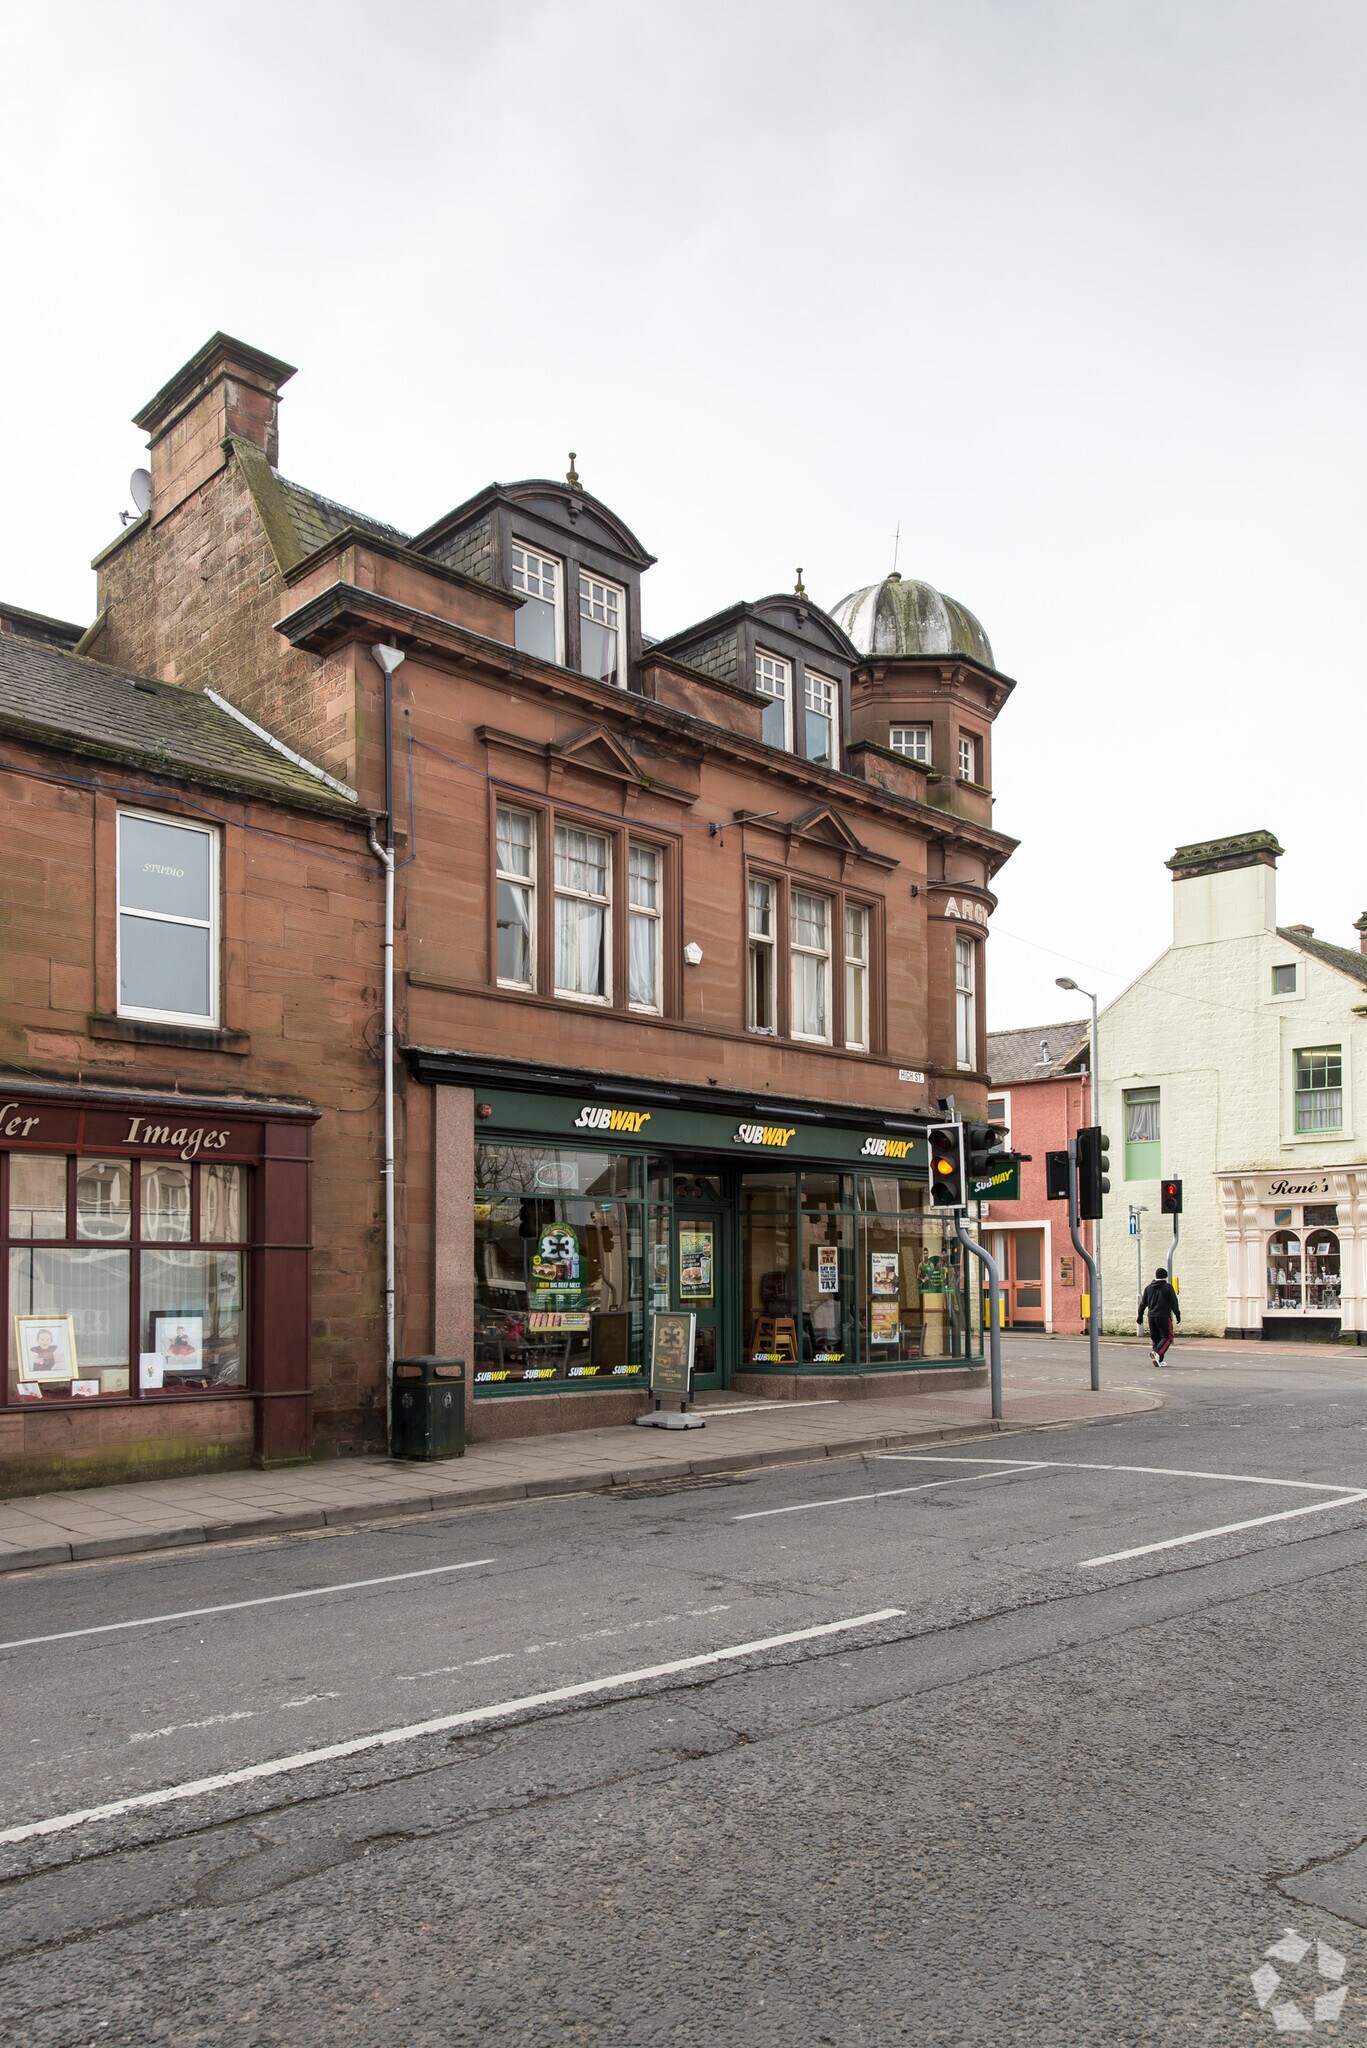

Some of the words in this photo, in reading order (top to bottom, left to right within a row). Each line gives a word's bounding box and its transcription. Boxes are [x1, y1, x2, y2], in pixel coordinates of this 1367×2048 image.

[143, 863, 184, 878] STUDIO
[900, 1071, 914, 1080] HIGH
[574, 1106, 651, 1133] SUBWAY
[122, 1117, 230, 1161] Images
[733, 1124, 796, 1147] SUBWAY
[860, 1137, 914, 1158] SUBWAY
[973, 1168, 1014, 1193] SUBWAY
[1268, 1178, 1329, 1195] René's
[541, 1235, 575, 1259] £3
[821, 1281, 836, 1289] TAX
[658, 1326, 685, 1348] £3
[752, 1353, 786, 1362] SUBWAY
[811, 1353, 845, 1362] SUBWAY
[475, 1371, 511, 1382] SUBWAY
[523, 1368, 556, 1379] SUBWAY
[568, 1366, 600, 1377] SUBWAY
[612, 1364, 641, 1374] SUBWAY
